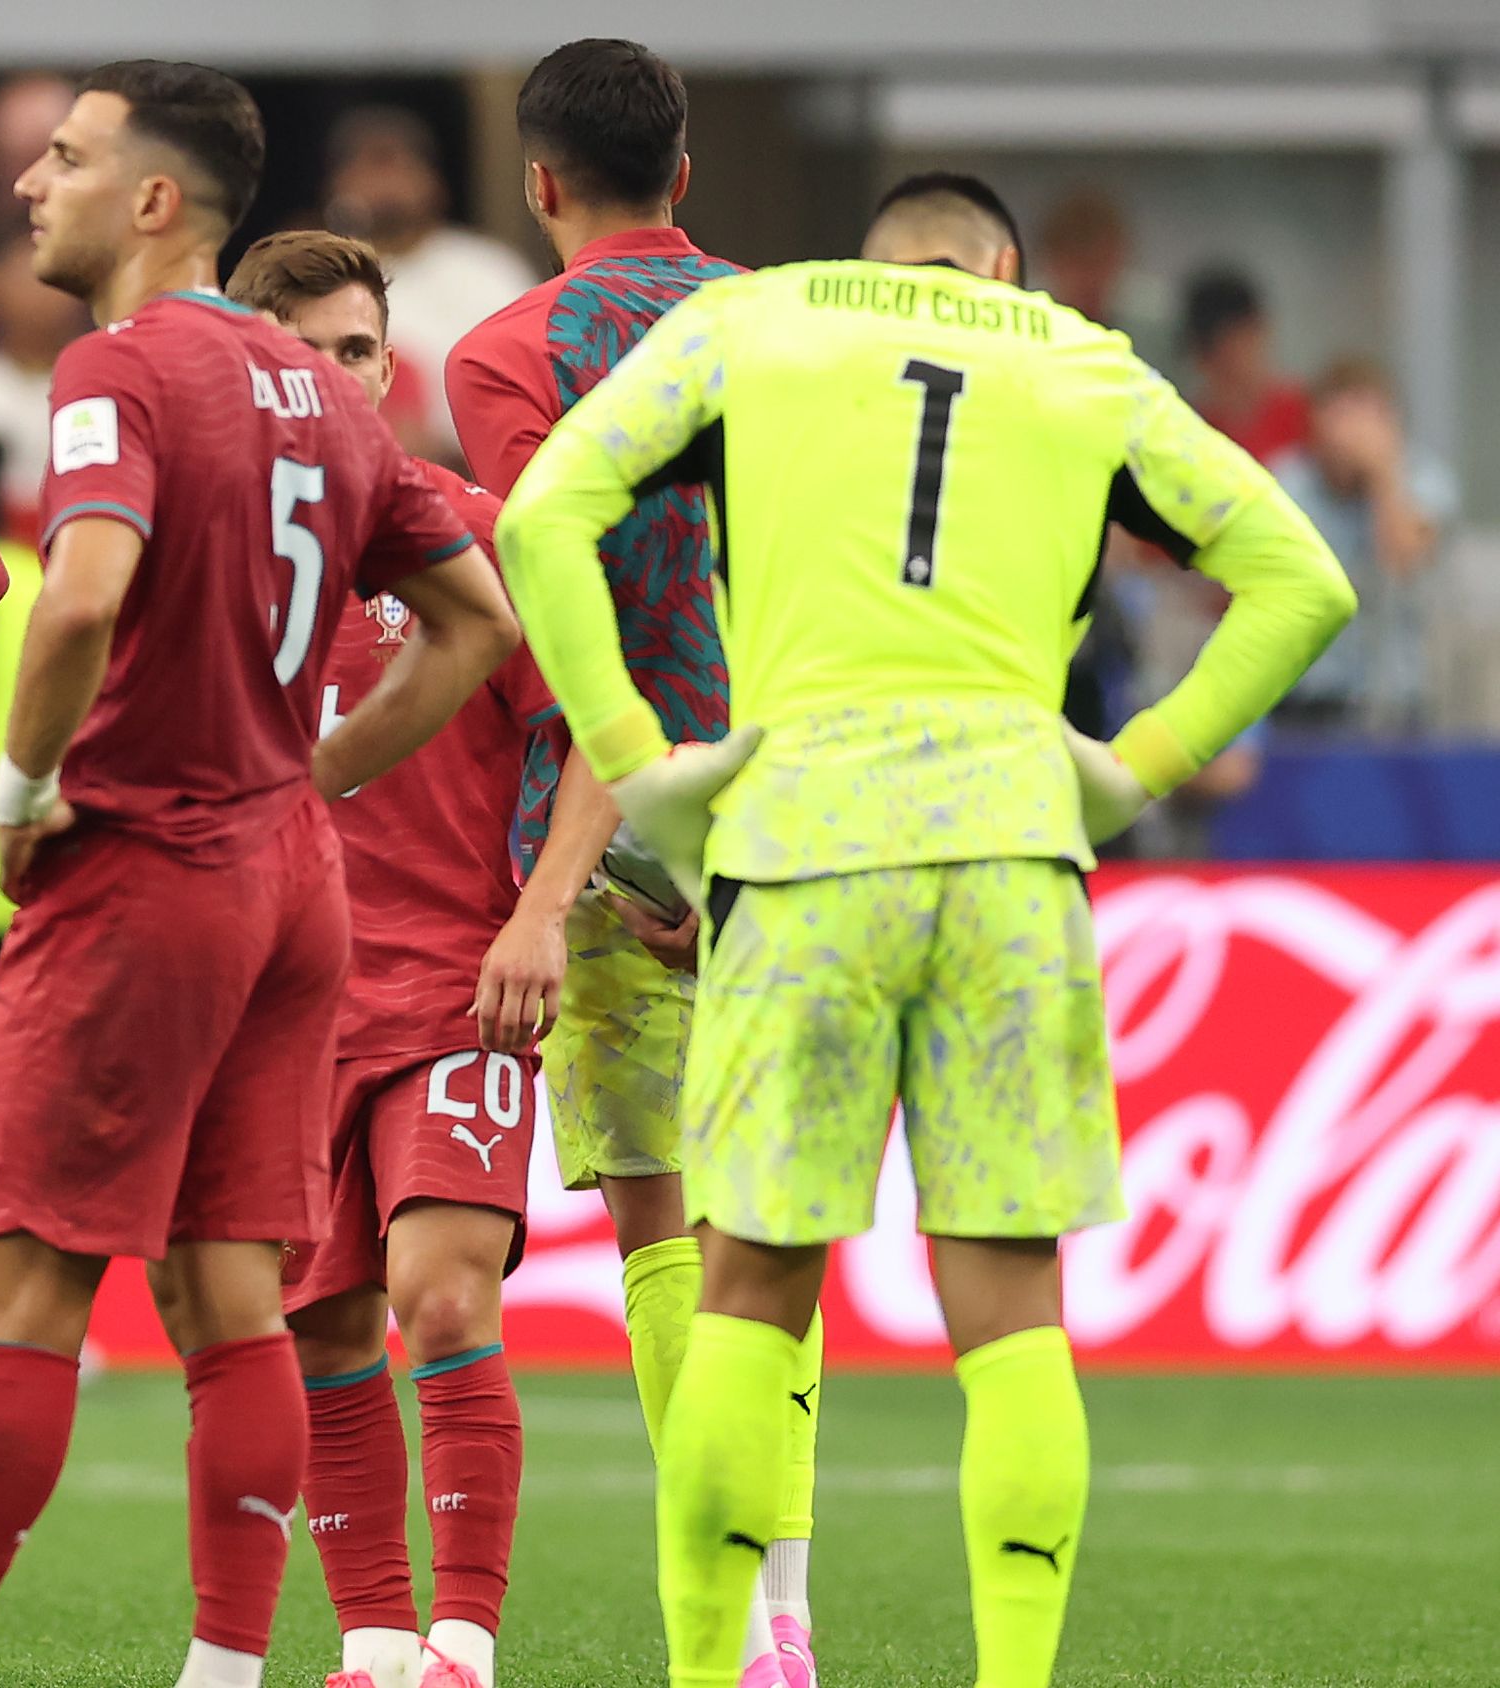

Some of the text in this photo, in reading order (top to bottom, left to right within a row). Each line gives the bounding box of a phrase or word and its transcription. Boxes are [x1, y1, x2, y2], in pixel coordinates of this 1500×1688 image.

[932, 289, 1049, 340] COSTA
[902, 358, 965, 588] 1
[271, 455, 325, 687] 5
[426, 1049, 522, 1129] 20
